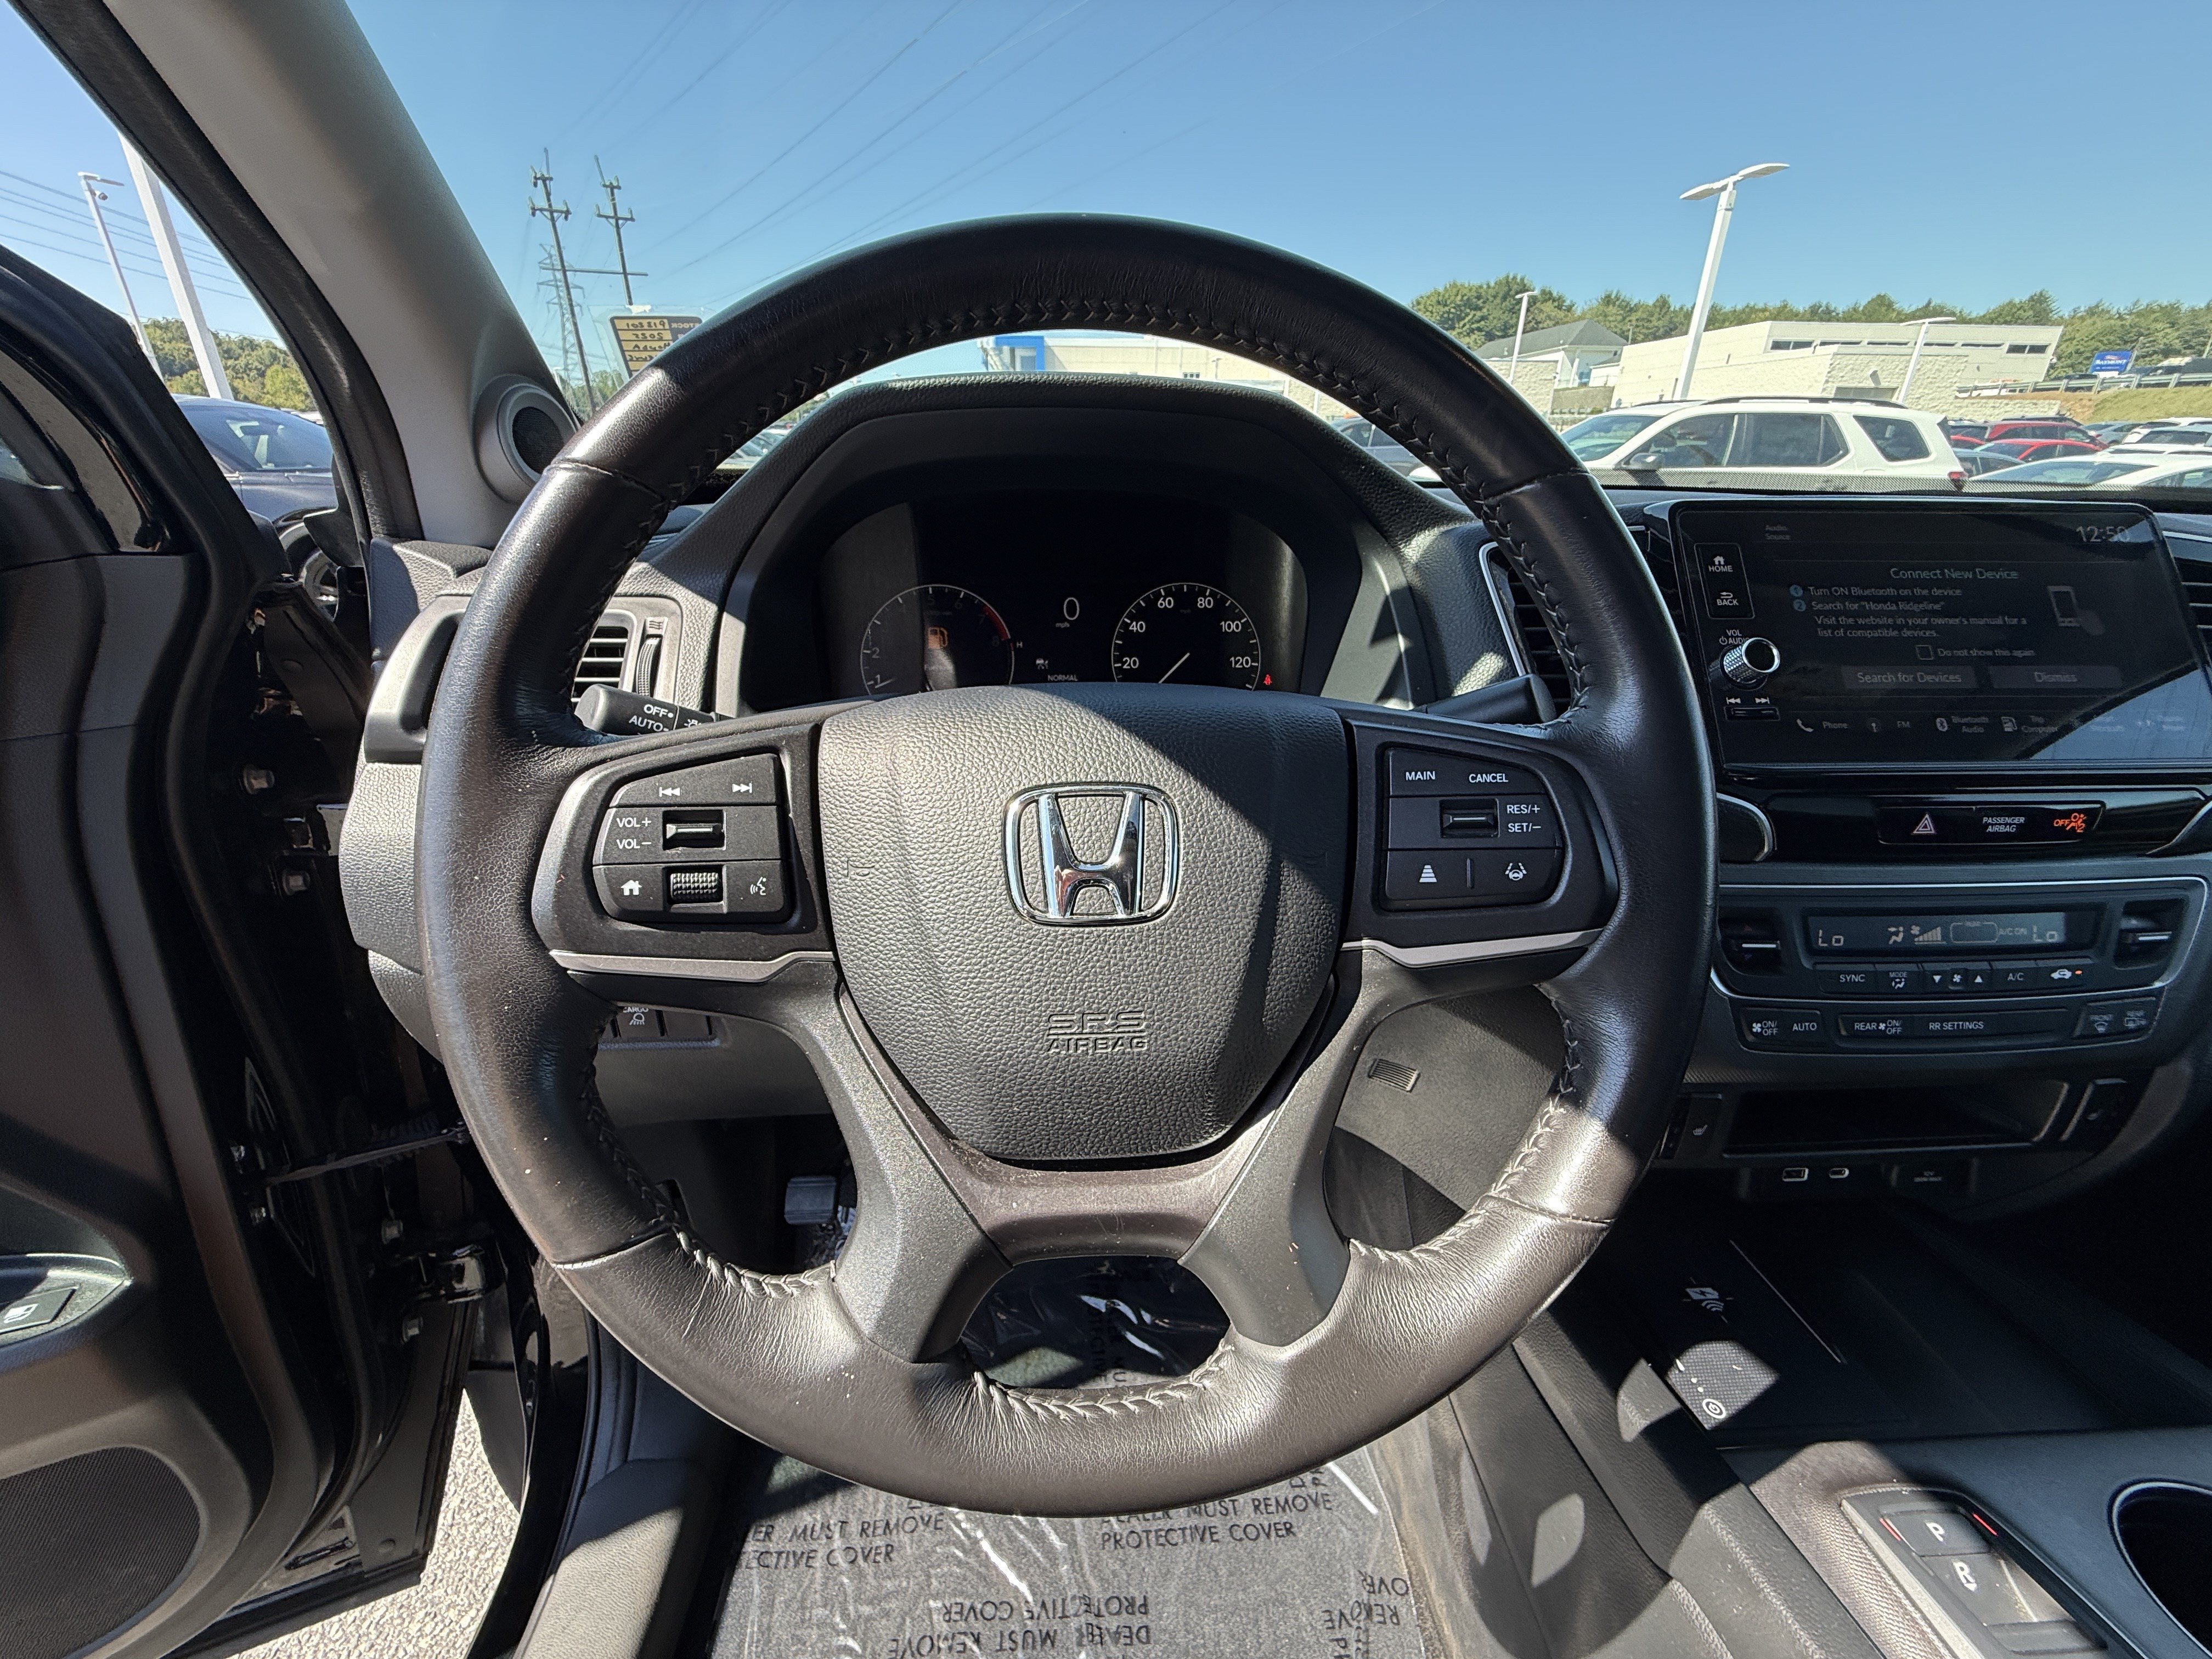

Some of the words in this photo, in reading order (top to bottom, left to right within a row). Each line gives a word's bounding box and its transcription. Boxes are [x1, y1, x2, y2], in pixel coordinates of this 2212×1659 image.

[1890, 568, 1942, 579] Connect
[1946, 569, 1972, 579] New
[1976, 568, 2019, 579] Device
[1808, 586, 1830, 596] Turn
[1832, 587, 1849, 596] ON
[1851, 586, 1897, 596] Bluetooth
[1913, 587, 1929, 596] the
[1931, 587, 1962, 596] device
[1157, 597, 1175, 609] 60
[1197, 597, 1214, 609] 80
[1716, 597, 1739, 606] BACK
[1812, 601, 1843, 611] Search
[1846, 601, 1859, 611] for
[1063, 597, 1080, 620] 0
[1128, 620, 1146, 633] 40
[1219, 620, 1242, 633] 100
[1815, 616, 1836, 625] Visit
[1838, 616, 1855, 625] the
[1857, 616, 1894, 625] website
[1896, 616, 1905, 625] in
[1907, 618, 1928, 627] your
[1970, 616, 2003, 625] manual
[1818, 628, 1833, 637] list
[1835, 628, 1845, 637] of
[1847, 628, 1899, 639] compatible
[1122, 657, 1139, 669] 20
[1229, 657, 1252, 669] 120
[1857, 672, 1896, 684] Search
[1898, 672, 1915, 684] for
[1917, 672, 1962, 684] Devices
[2034, 672, 2078, 683] Dismiss
[643, 704, 667, 717] OFF
[1822, 721, 1848, 730] Phone
[1897, 721, 1911, 729] FM
[1406, 770, 1436, 781] MAIN
[1469, 773, 1509, 783] CANCEL
[1506, 804, 1541, 815] RES/+
[1982, 816, 2025, 825] PASSENGER
[1986, 824, 2017, 833] AIRBAG
[1818, 929, 1844, 947] Lo
[2032, 925, 2058, 943] Lo
[1839, 974, 1865, 983] SYNC
[2007, 972, 2024, 982] A/C
[1046, 1011, 1147, 1032] SRS
[1762, 1020, 1778, 1030] ON/
[1792, 1022, 1817, 1031] AUTO
[1854, 1022, 1877, 1031] REAR
[1886, 1019, 1903, 1029] ON/
[1928, 1022, 1942, 1031] RR
[1943, 1021, 1984, 1031] SETTINGS
[1762, 1028, 1779, 1036] OFF
[1886, 1027, 1903, 1036] OFF
[1046, 1036, 1148, 1054] AIRBAG
[1185, 1499, 1238, 1518] MUST
[1251, 1492, 1333, 1516] REMOVE
[788, 1520, 849, 1543] MUST
[859, 1514, 945, 1538] REMOVE
[1925, 1521, 1945, 1542] P
[1101, 1525, 1220, 1550] PROTECTIVE
[1228, 1521, 1296, 1542] COVER
[826, 1543, 895, 1567] COVER
[1952, 1560, 1976, 1584] R
[941, 1600, 1013, 1623] COVER
[1322, 1599, 1400, 1630] REMOVE
[995, 1628, 1058, 1652] MUST
